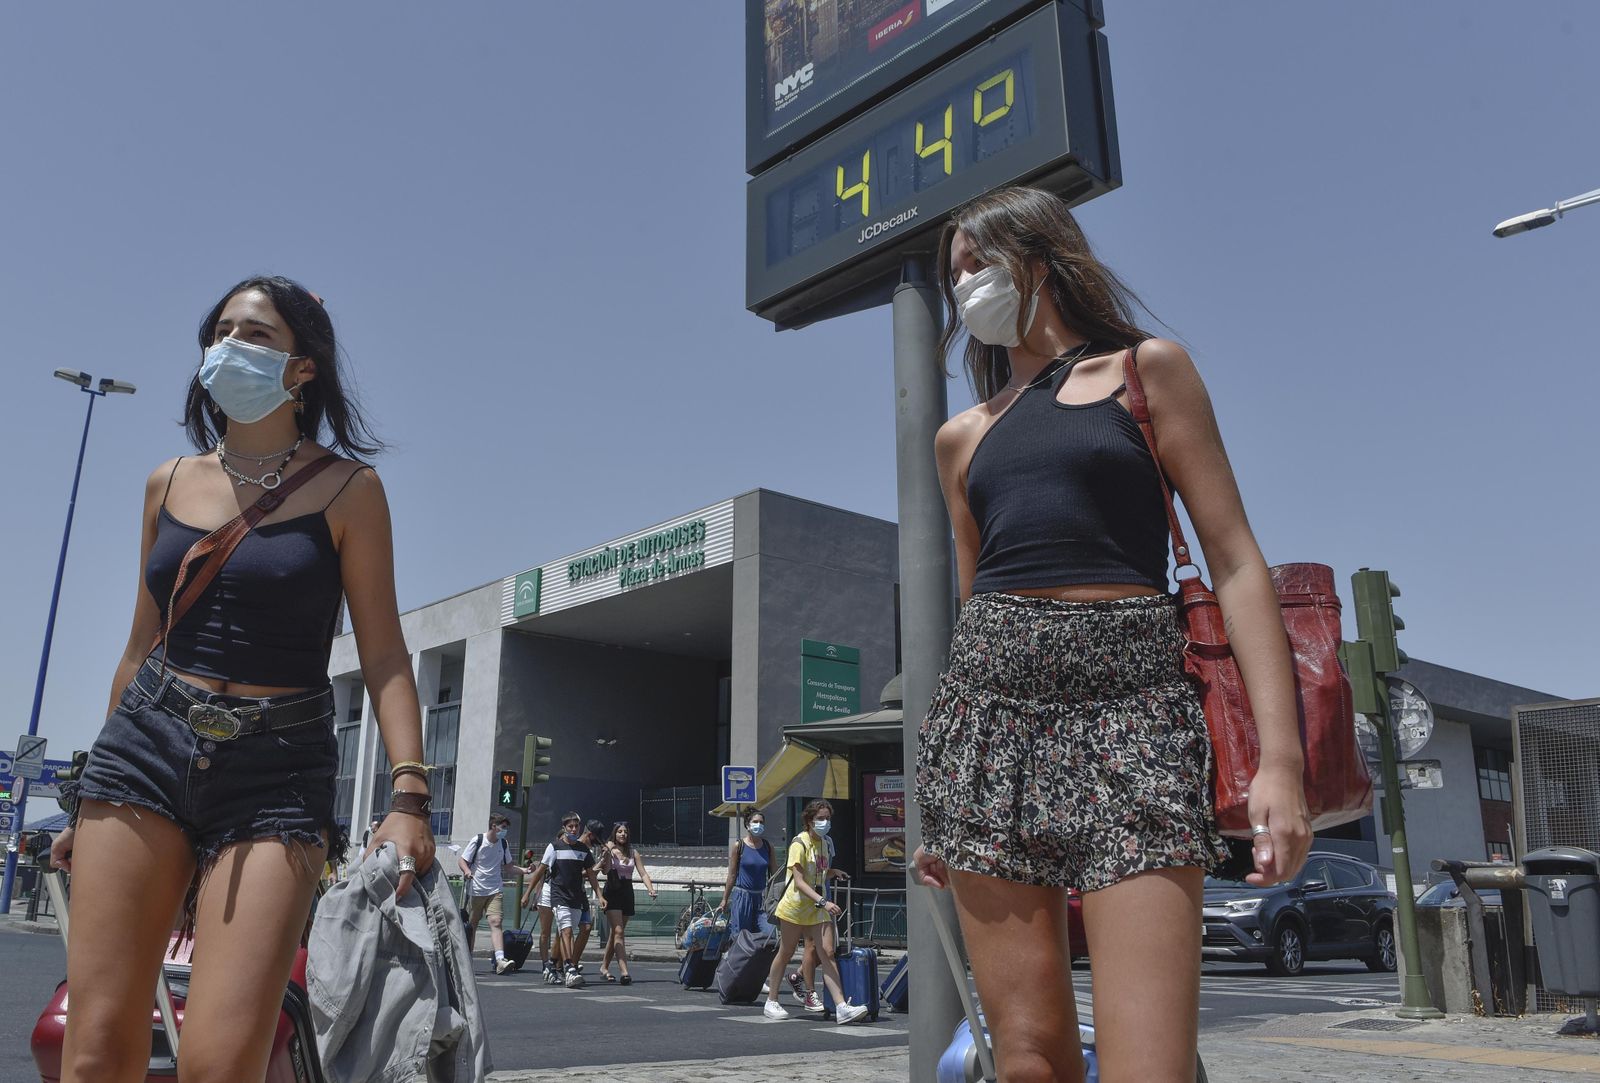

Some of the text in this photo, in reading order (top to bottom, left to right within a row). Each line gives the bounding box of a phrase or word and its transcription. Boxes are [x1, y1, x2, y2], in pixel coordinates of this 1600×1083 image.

[875, 19, 903, 40] IBERIA
[774, 62, 814, 101] NYC
[857, 205, 919, 244] JCDecaux
[566, 518, 706, 582] ESTACIÓN DE AUTOBUSES
[619, 549, 705, 588] Plaza de Armas
[826, 704, 833, 712] de
[834, 705, 851, 714] Sevilla
